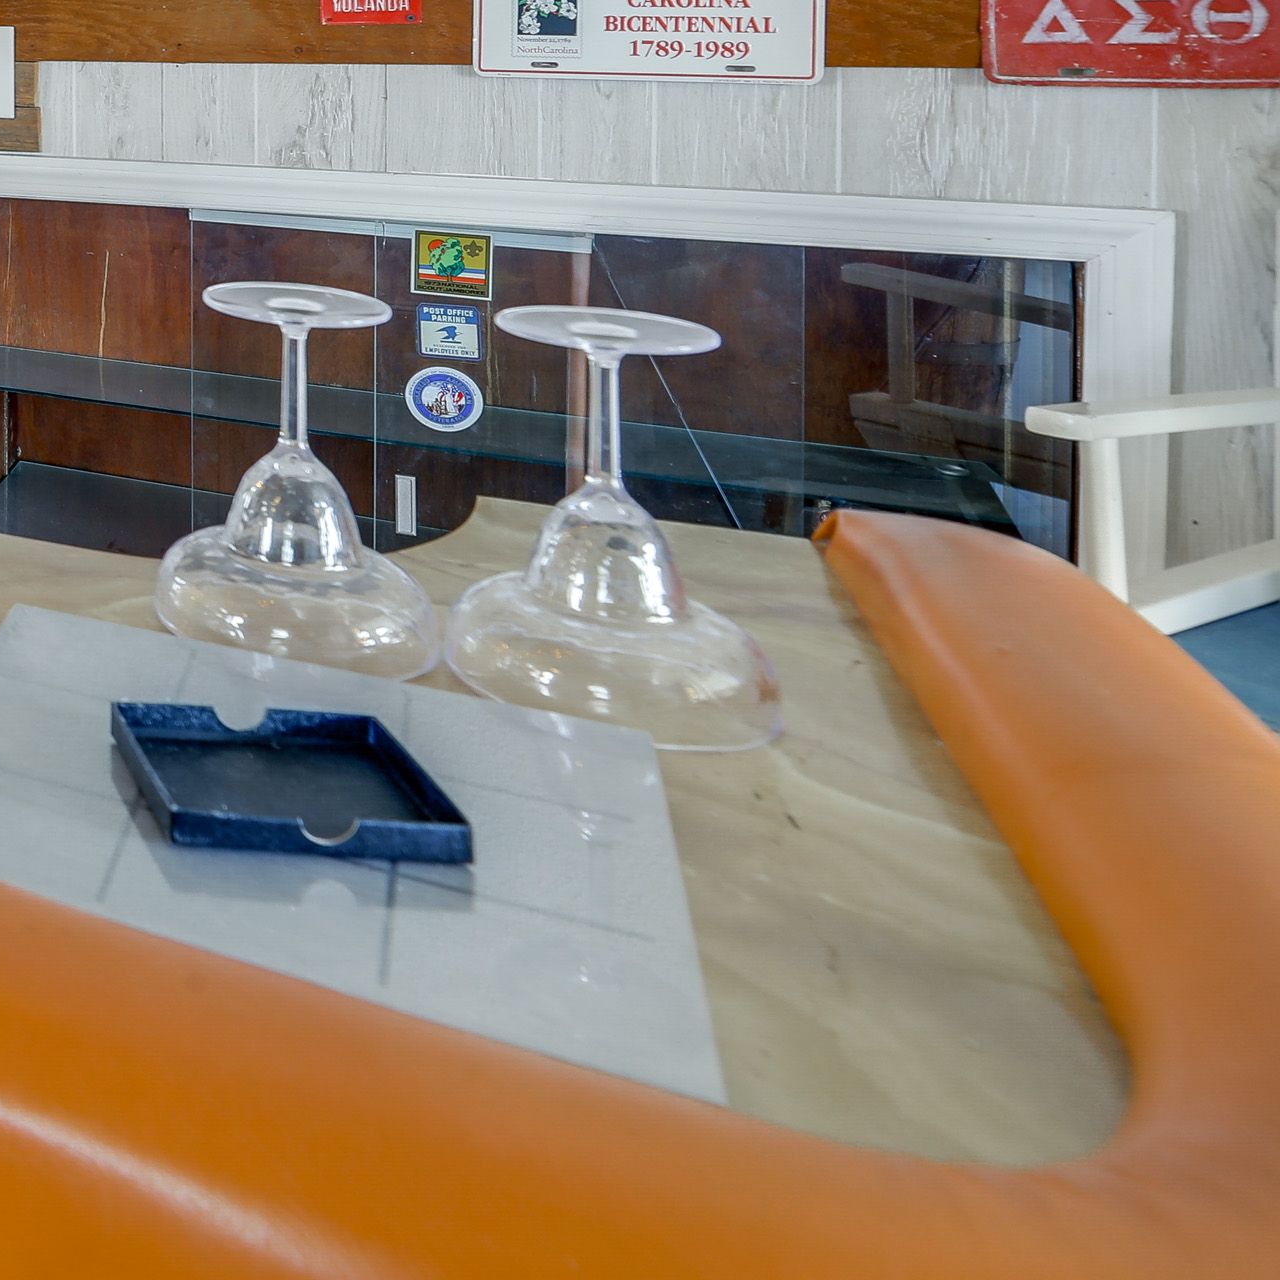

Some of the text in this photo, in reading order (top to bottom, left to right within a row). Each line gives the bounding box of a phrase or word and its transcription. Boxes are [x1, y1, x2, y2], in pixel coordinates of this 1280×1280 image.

[603, 15, 777, 34] BICENTENNIAL
[628, 40, 751, 61] 1789-1989
[423, 307, 474, 317] POST OFFICE
[431, 315, 466, 323] PARKING
[425, 347, 459, 355] EMPLOYEES
